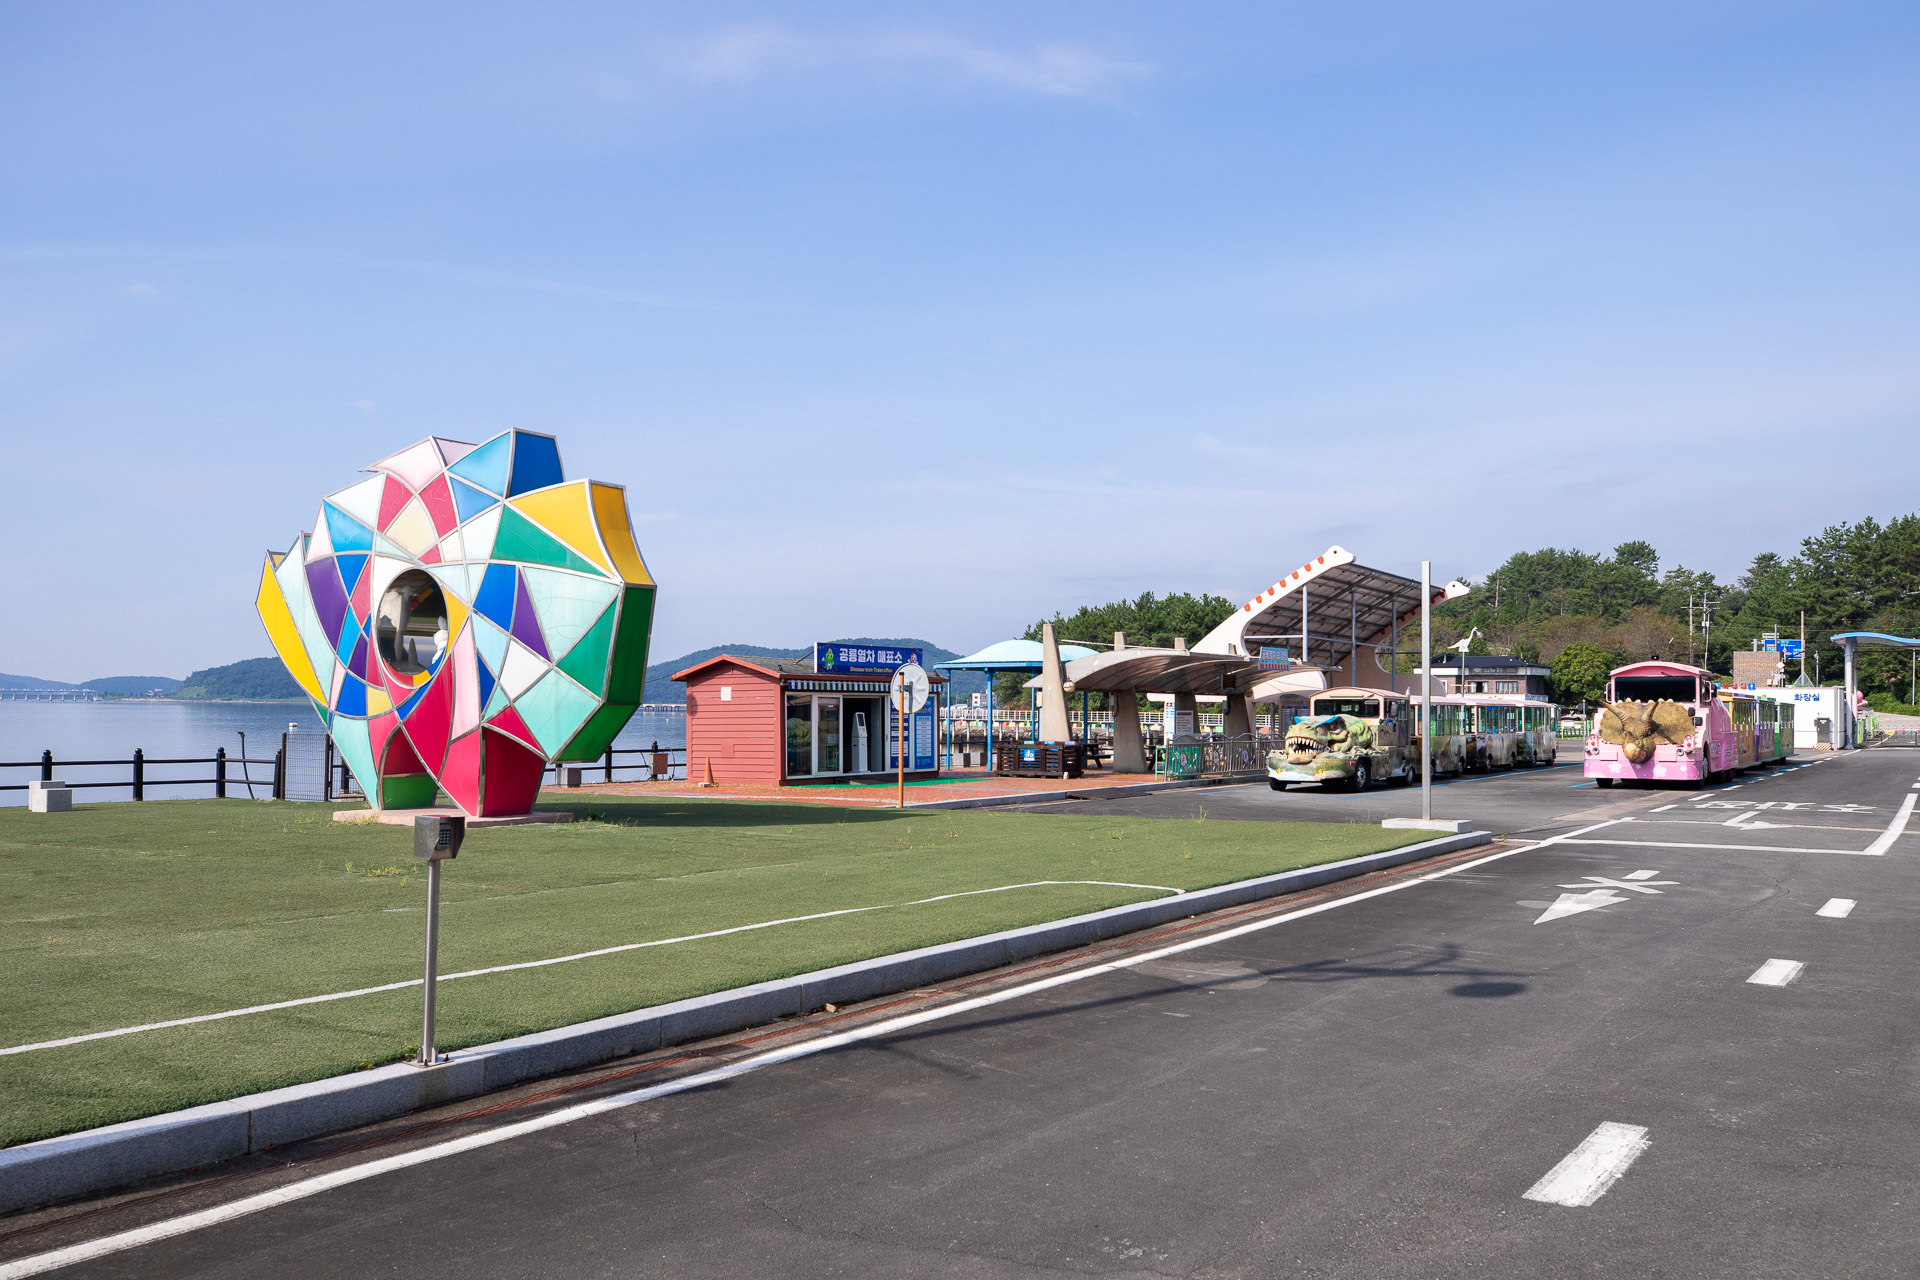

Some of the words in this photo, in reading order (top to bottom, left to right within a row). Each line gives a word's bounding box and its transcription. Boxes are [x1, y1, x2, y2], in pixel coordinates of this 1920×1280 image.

[839, 647, 875, 663] 공룡열차
[877, 650, 903, 664] 매표소
[1794, 693, 1820, 701] 화장실
[1693, 800, 1878, 814] 주차장
